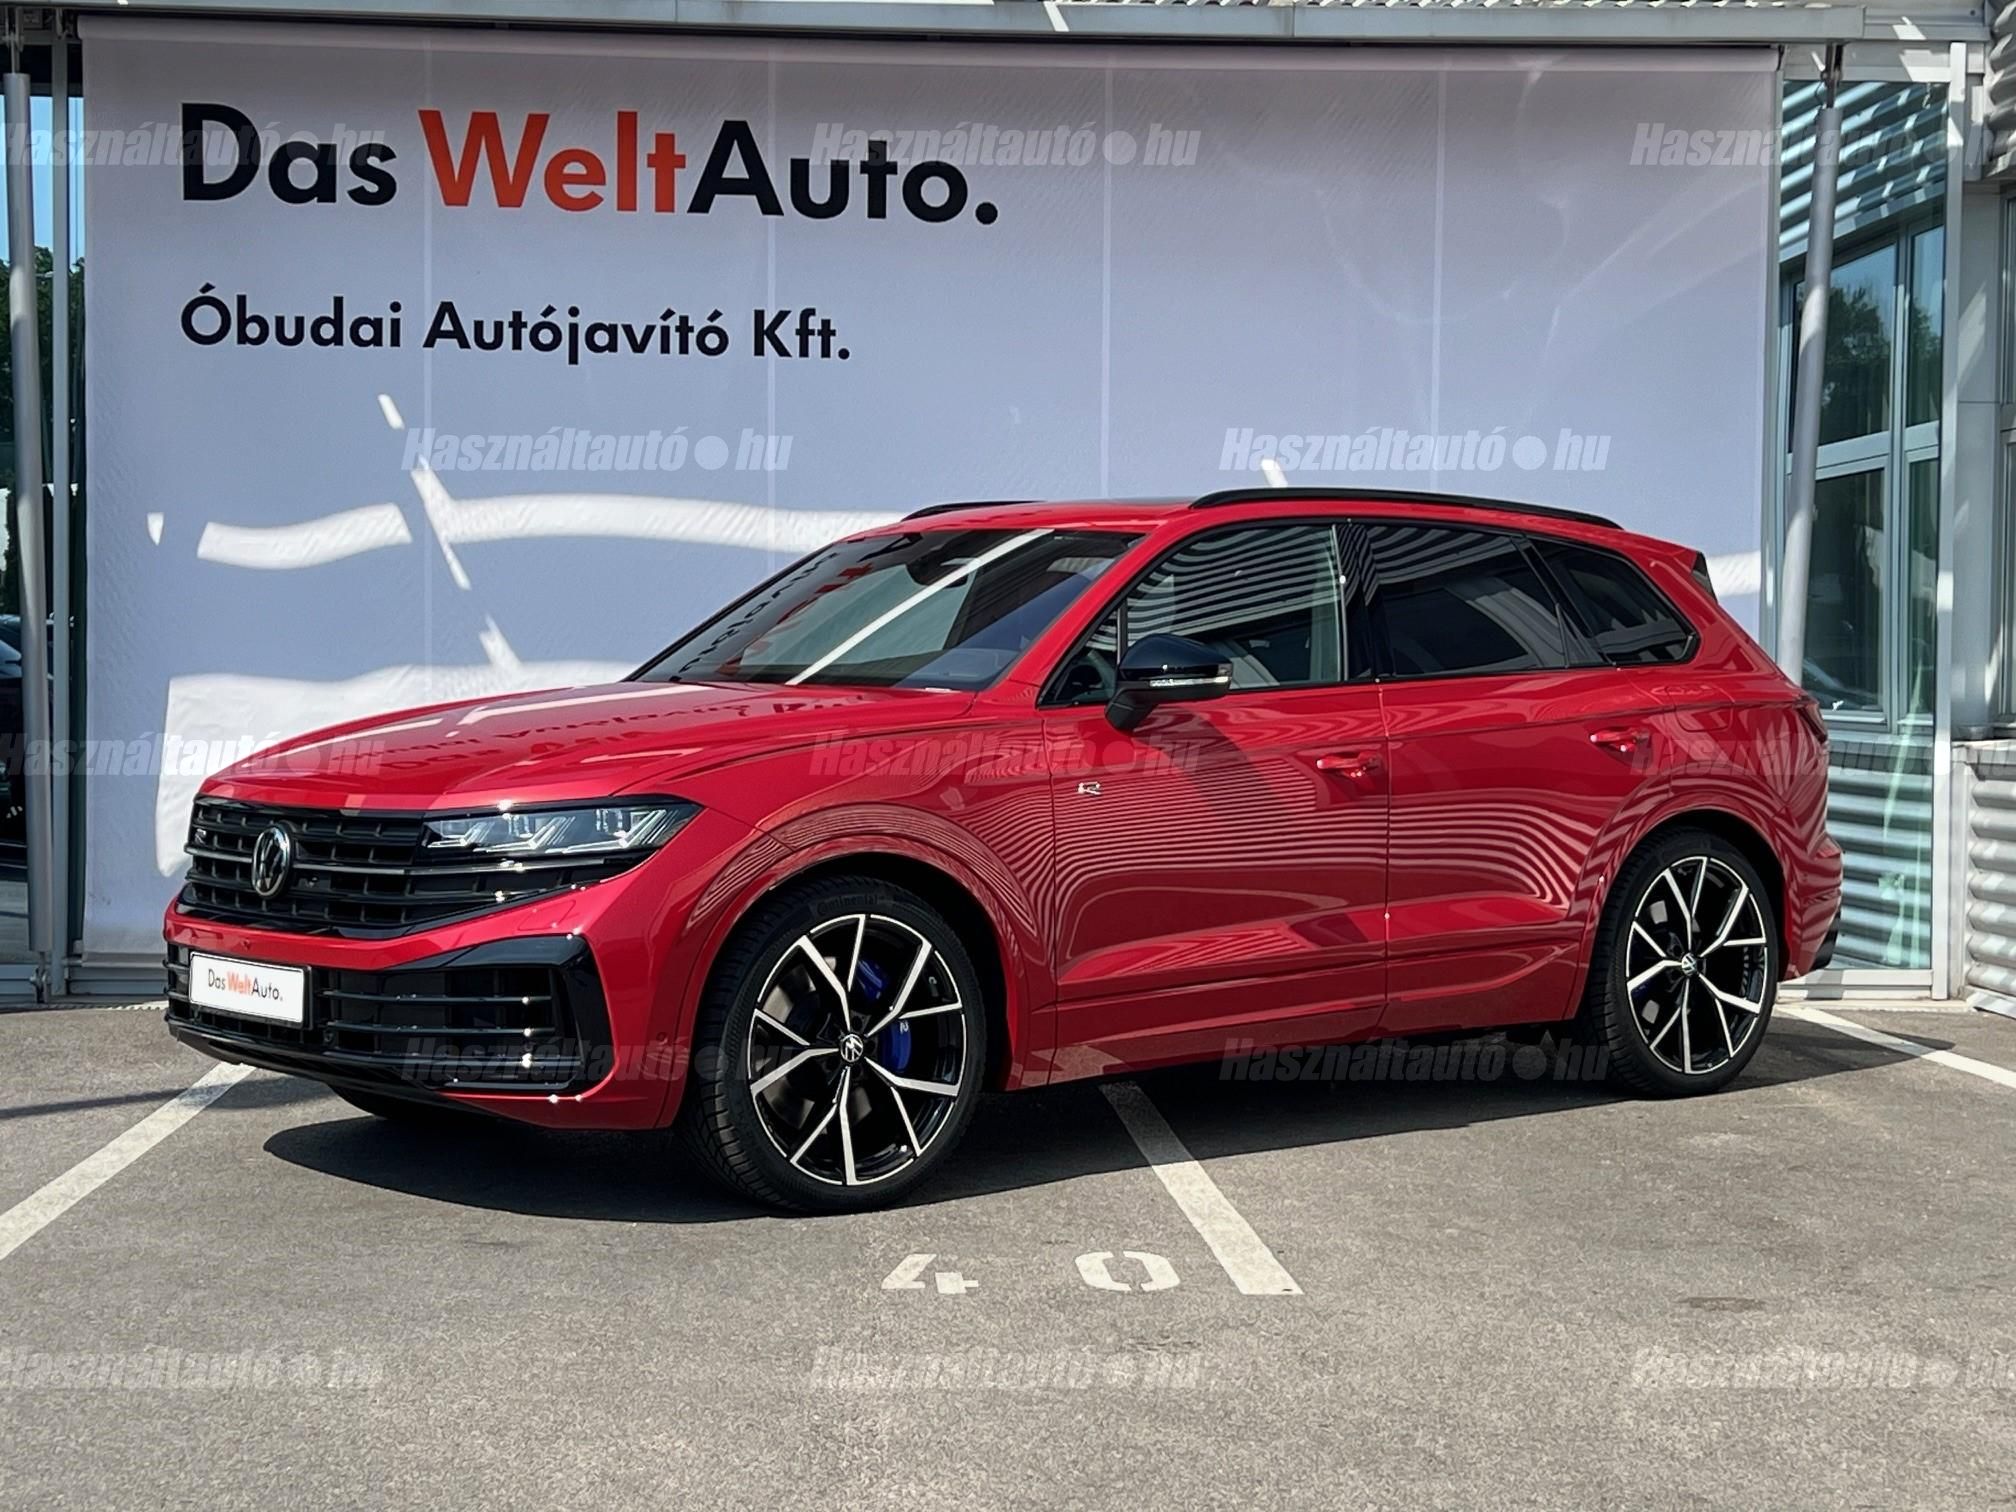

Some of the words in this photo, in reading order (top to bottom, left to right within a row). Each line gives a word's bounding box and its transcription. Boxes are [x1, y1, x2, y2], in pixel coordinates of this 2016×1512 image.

[181, 102, 397, 206] Das
[418, 110, 998, 225] WeltAuto.
[180, 282, 402, 348] Óbudai
[422, 303, 729, 365] Autójavító
[753, 308, 851, 360] Kft.
[208, 968, 226, 990] Das
